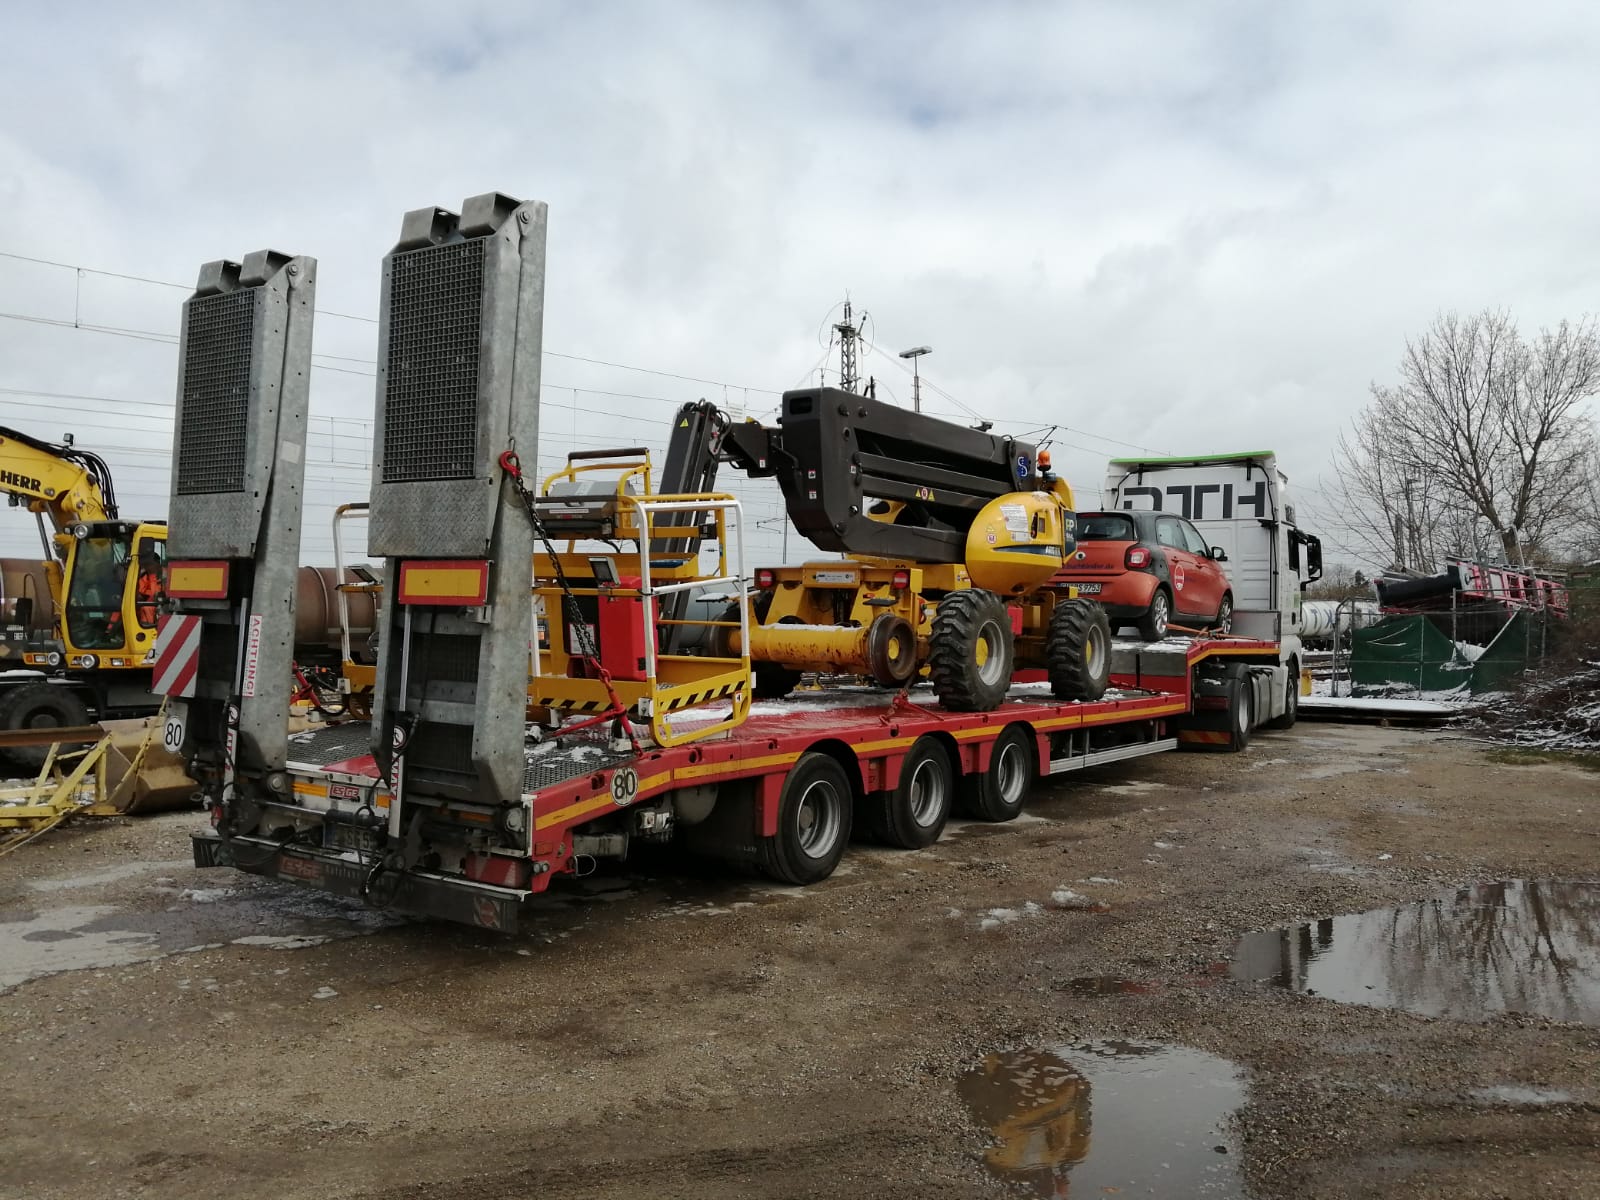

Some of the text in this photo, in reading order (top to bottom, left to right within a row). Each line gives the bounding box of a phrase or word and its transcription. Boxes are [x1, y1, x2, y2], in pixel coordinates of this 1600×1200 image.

[0, 470, 41, 492] HERR
[165, 722, 182, 747] 80
[614, 771, 636, 799] 80
